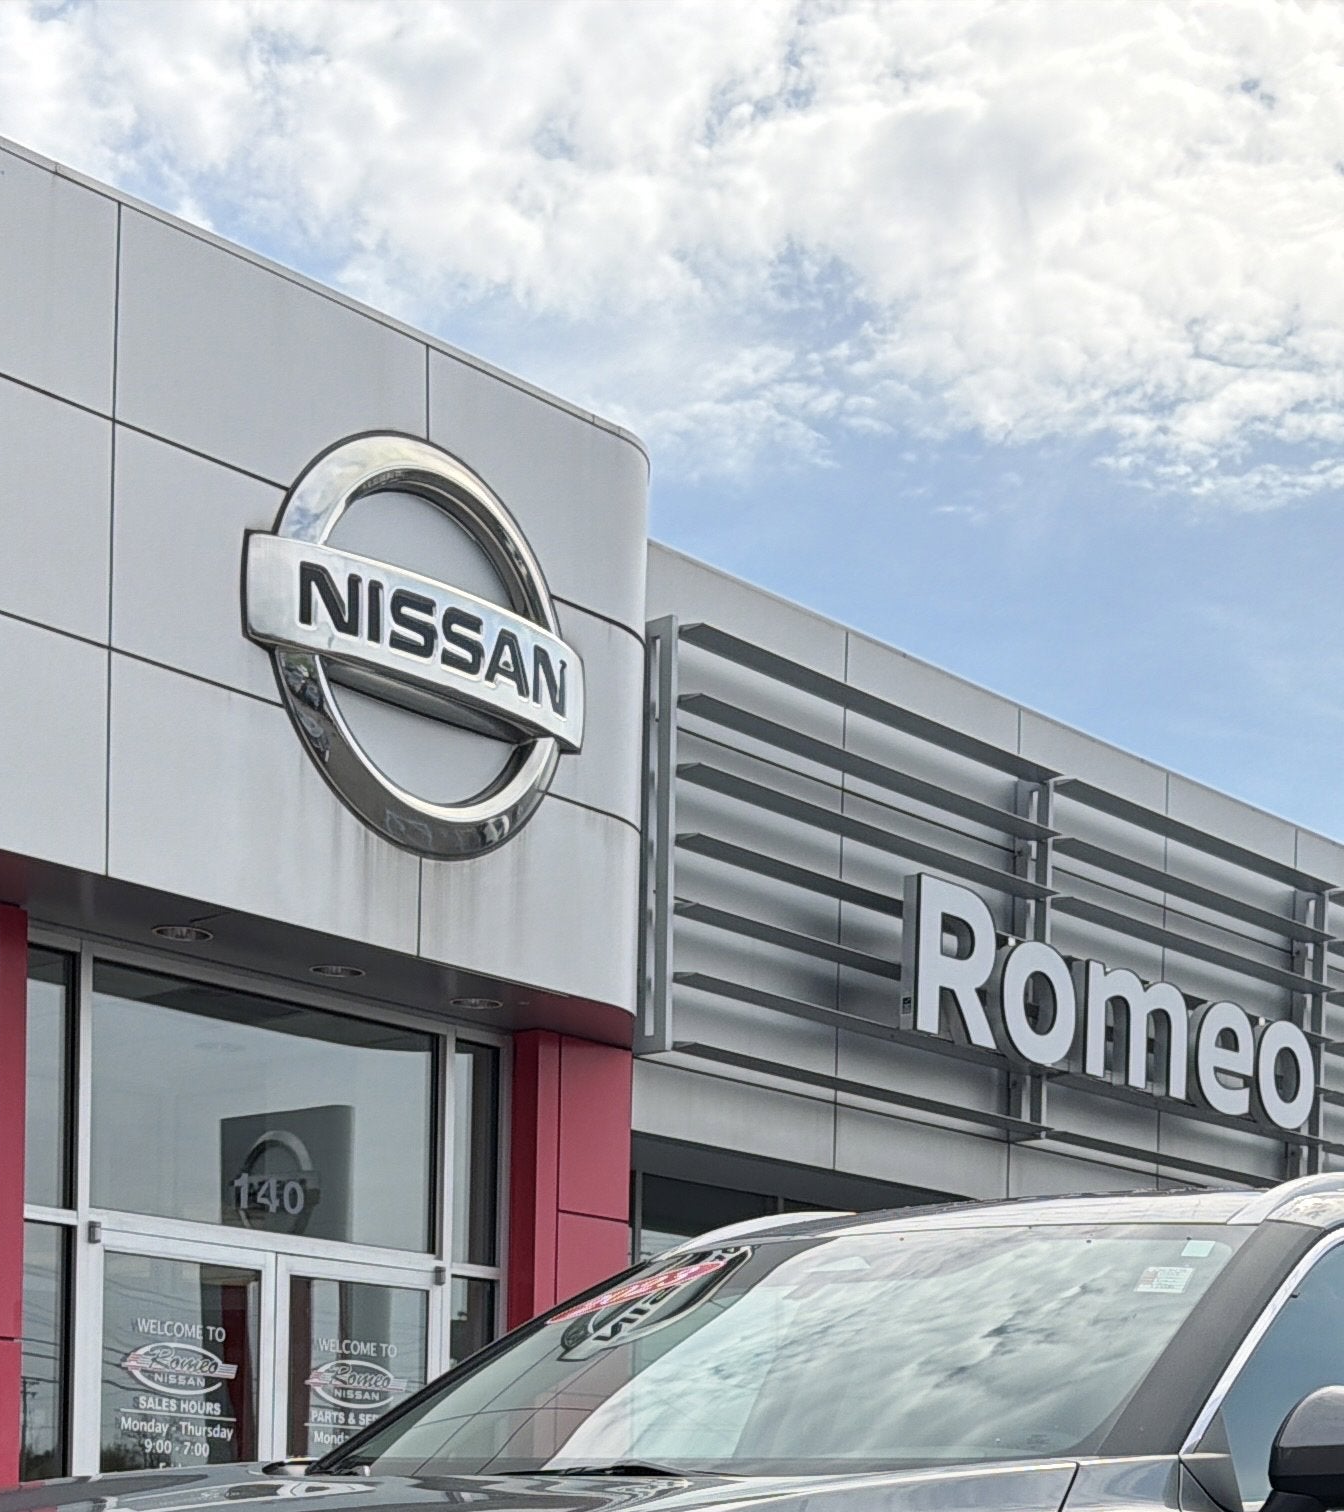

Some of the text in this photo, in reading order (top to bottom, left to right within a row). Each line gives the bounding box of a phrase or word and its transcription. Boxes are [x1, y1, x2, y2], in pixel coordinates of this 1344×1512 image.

[298, 560, 568, 719] NISSAN
[903, 872, 1316, 1130] Romeo
[234, 1172, 305, 1215] 140
[137, 1317, 226, 1342] WELCOME TO
[148, 1345, 219, 1375] Romeo
[318, 1338, 398, 1358] WELCOME TO
[153, 1372, 206, 1388] NISSAN
[329, 1362, 392, 1388] Romeo
[138, 1396, 222, 1416] SALES HOURS
[334, 1388, 380, 1401] NISSAN
[120, 1416, 169, 1437] Monday
[179, 1421, 234, 1441] Thursday
[311, 1409, 345, 1424] PARTS
[347, 1412, 356, 1425] &
[144, 1438, 172, 1454] 9:00
[183, 1441, 210, 1457] 7:00
